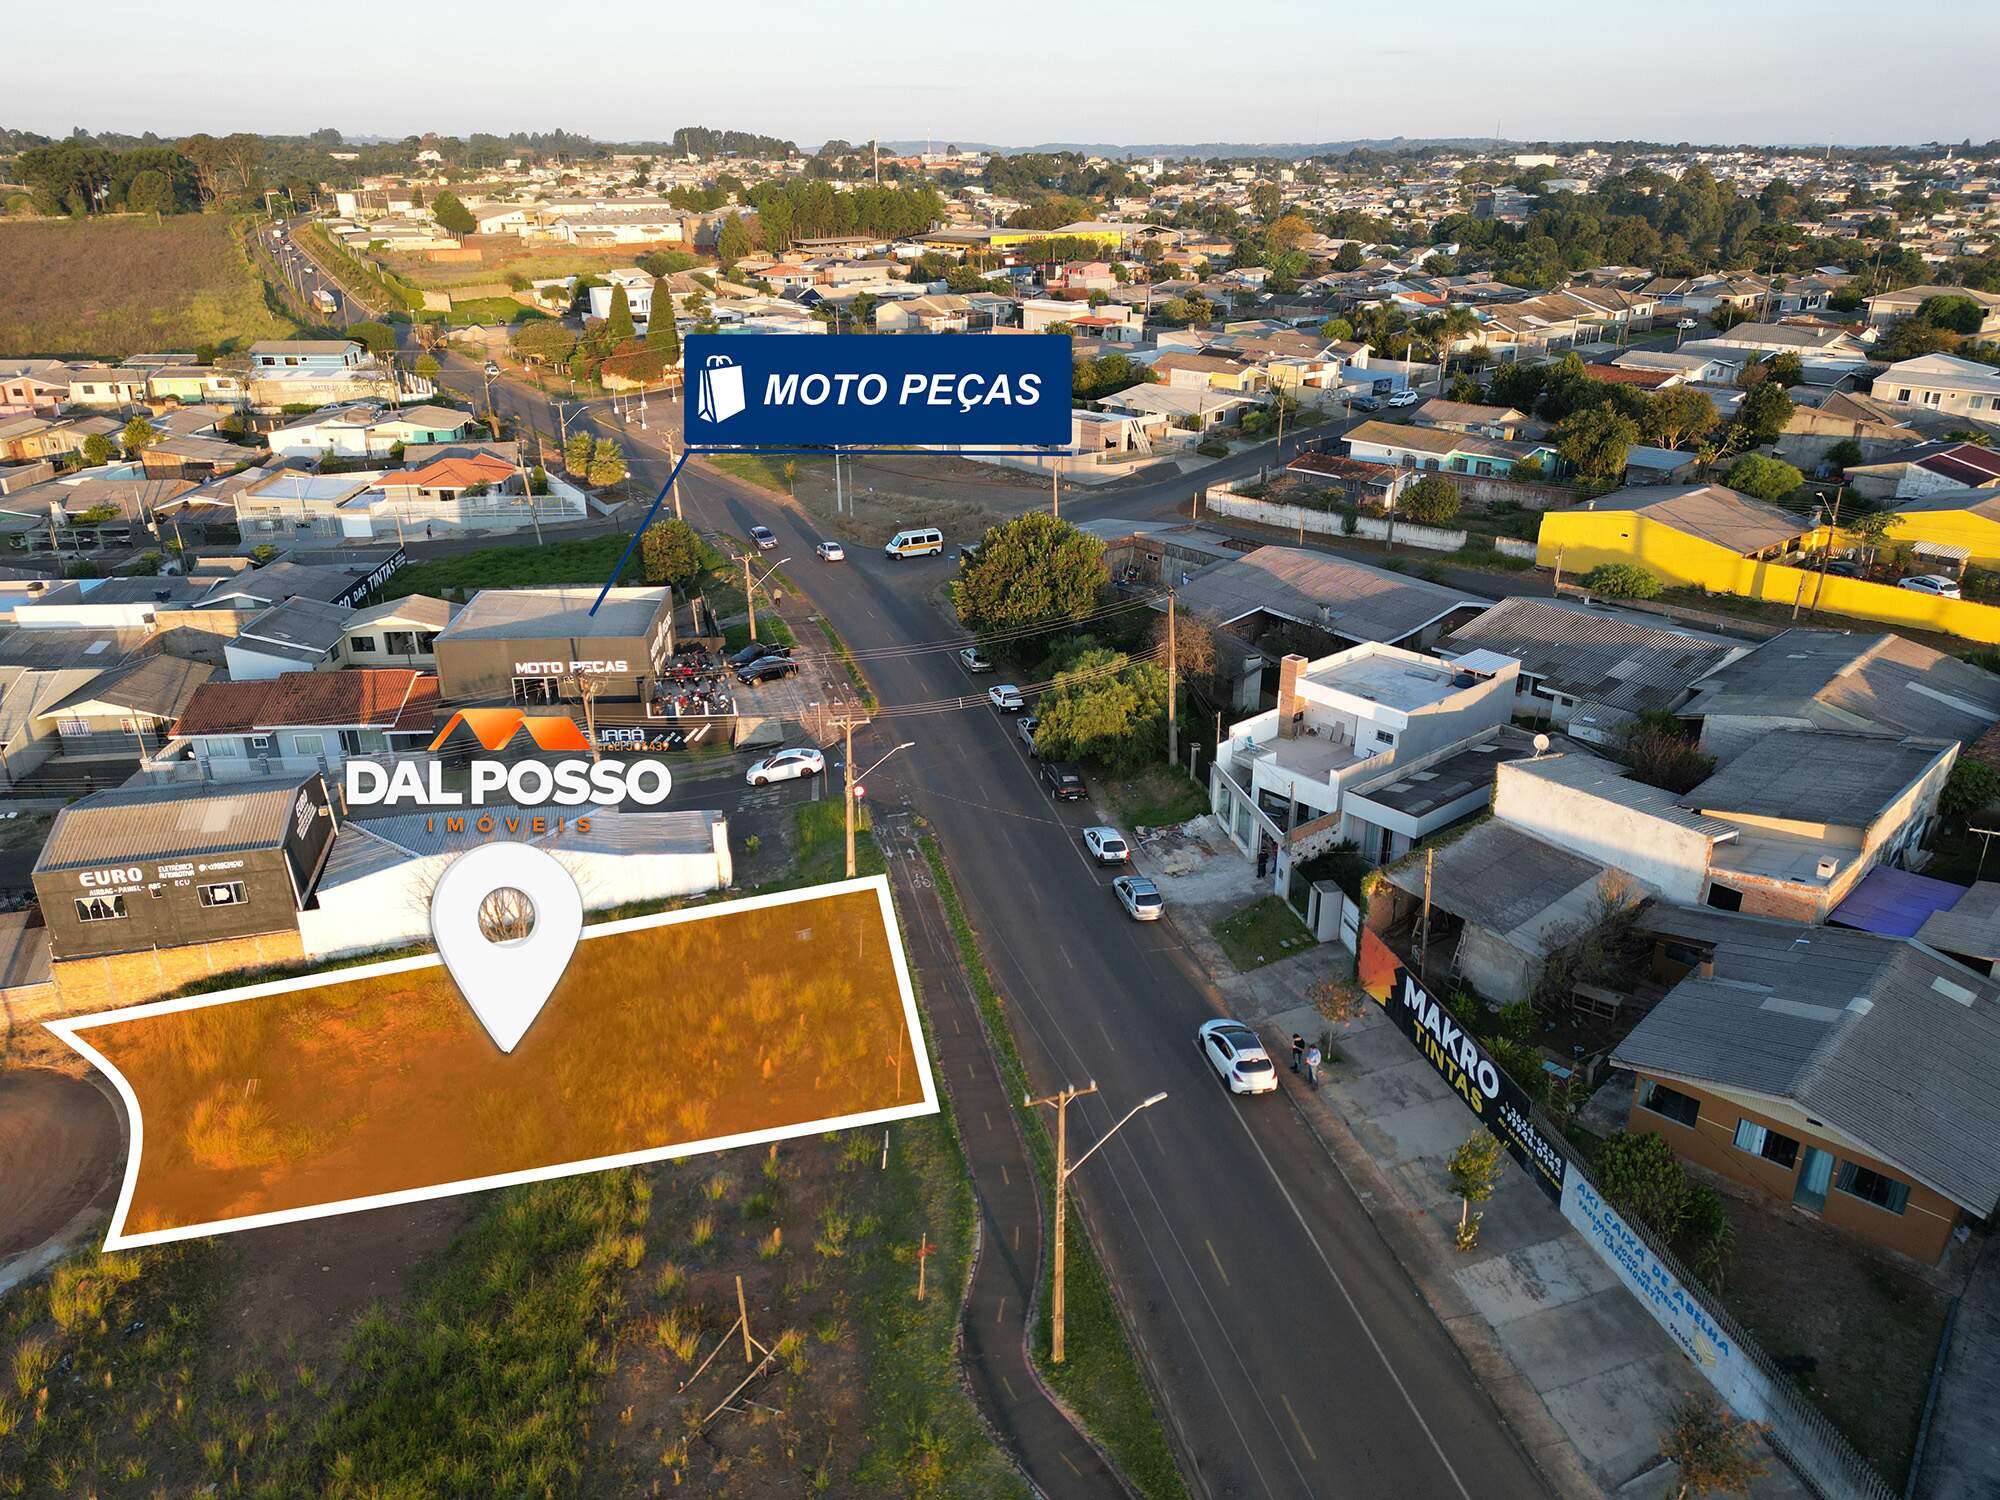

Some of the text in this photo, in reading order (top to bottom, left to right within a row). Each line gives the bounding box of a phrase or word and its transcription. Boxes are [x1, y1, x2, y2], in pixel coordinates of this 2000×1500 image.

[353, 583, 367, 602] DAS
[367, 559, 396, 592] TINTAS
[515, 662, 564, 674] MOTO
[79, 867, 143, 887] EURO
[1403, 975, 1499, 1099] MAKRO
[1413, 1019, 1483, 1114] TINTAS
[1577, 1183, 1729, 1357] AKI CAIXA DE ABELHA
[1603, 1237, 1660, 1305] LANCHONETE
